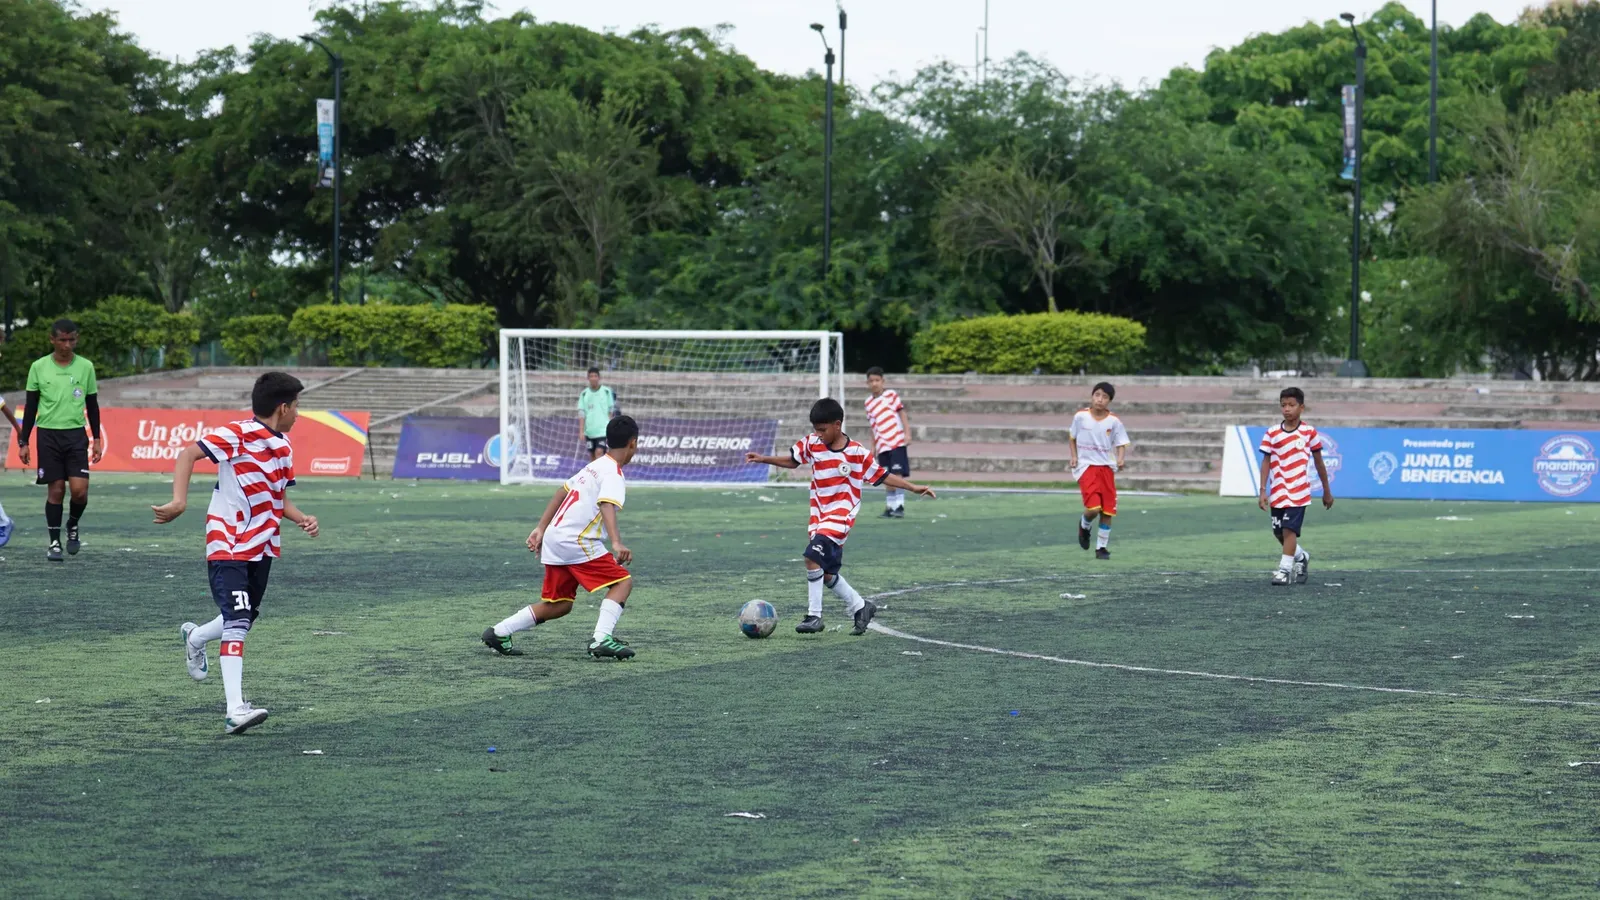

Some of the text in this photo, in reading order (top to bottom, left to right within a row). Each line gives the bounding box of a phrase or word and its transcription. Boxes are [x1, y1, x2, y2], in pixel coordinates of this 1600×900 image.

[138, 419, 167, 441] Un
[636, 435, 752, 450] CIDAD EXTERIOR
[1403, 438, 1475, 450] Presentado por:
[416, 452, 483, 464] PUBLI
[631, 453, 717, 466] ww.publiarte.ec
[1402, 453, 1474, 468] JUNTA DE
[1536, 460, 1596, 471] marathon
[1401, 469, 1505, 483] BENEFICENCIA
[228, 641, 240, 654] C
